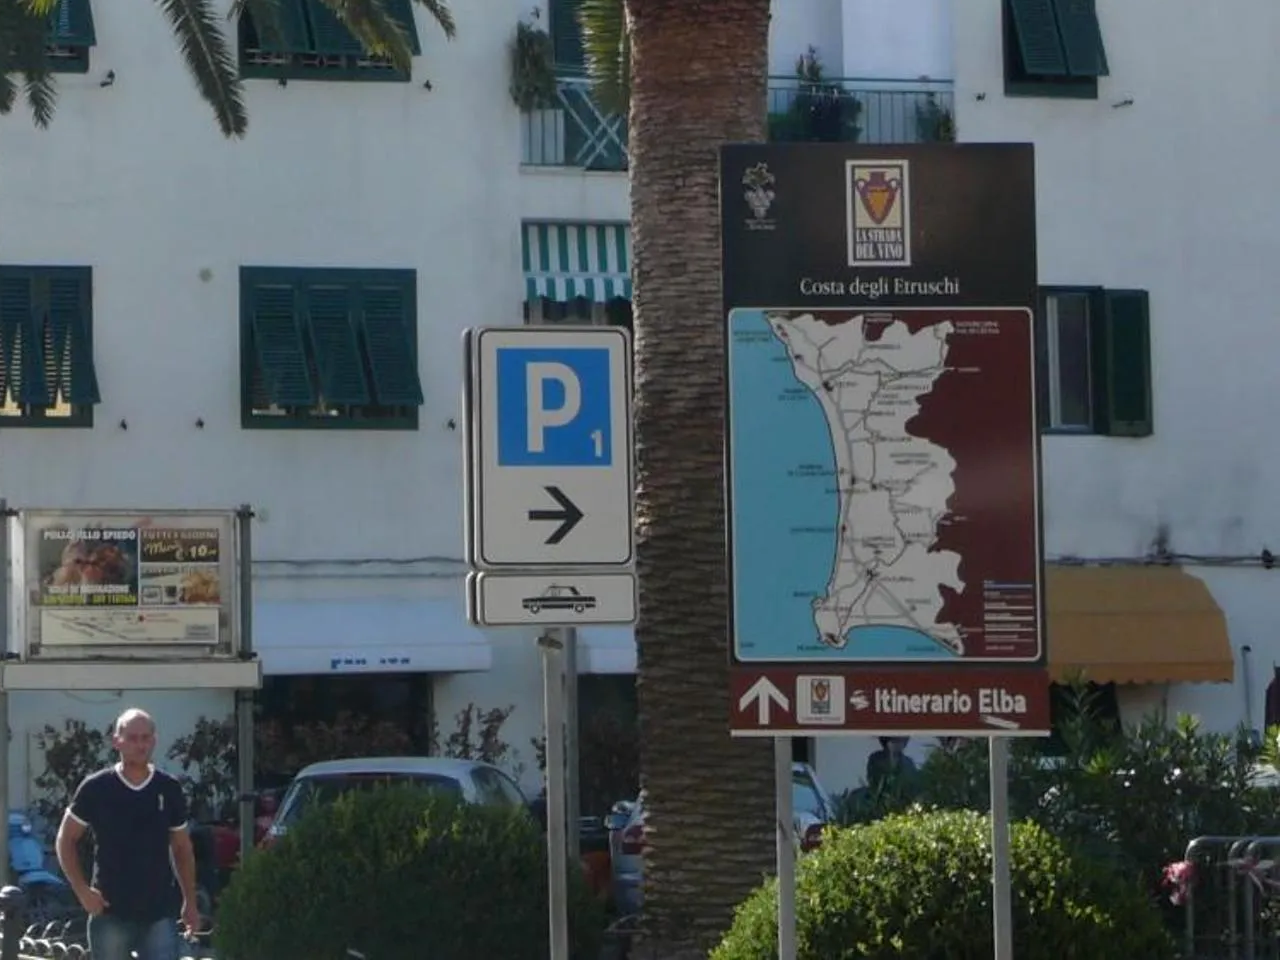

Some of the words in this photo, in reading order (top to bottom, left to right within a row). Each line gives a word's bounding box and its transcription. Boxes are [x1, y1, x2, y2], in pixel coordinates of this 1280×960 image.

[878, 243, 903, 260] VINO
[800, 278, 845, 296] Costa
[849, 277, 889, 300] degli
[894, 277, 959, 296] Etruschi
[526, 361, 582, 453] P
[590, 428, 603, 458] 1
[875, 687, 971, 714] Itinerario
[978, 687, 1027, 713] Elba
